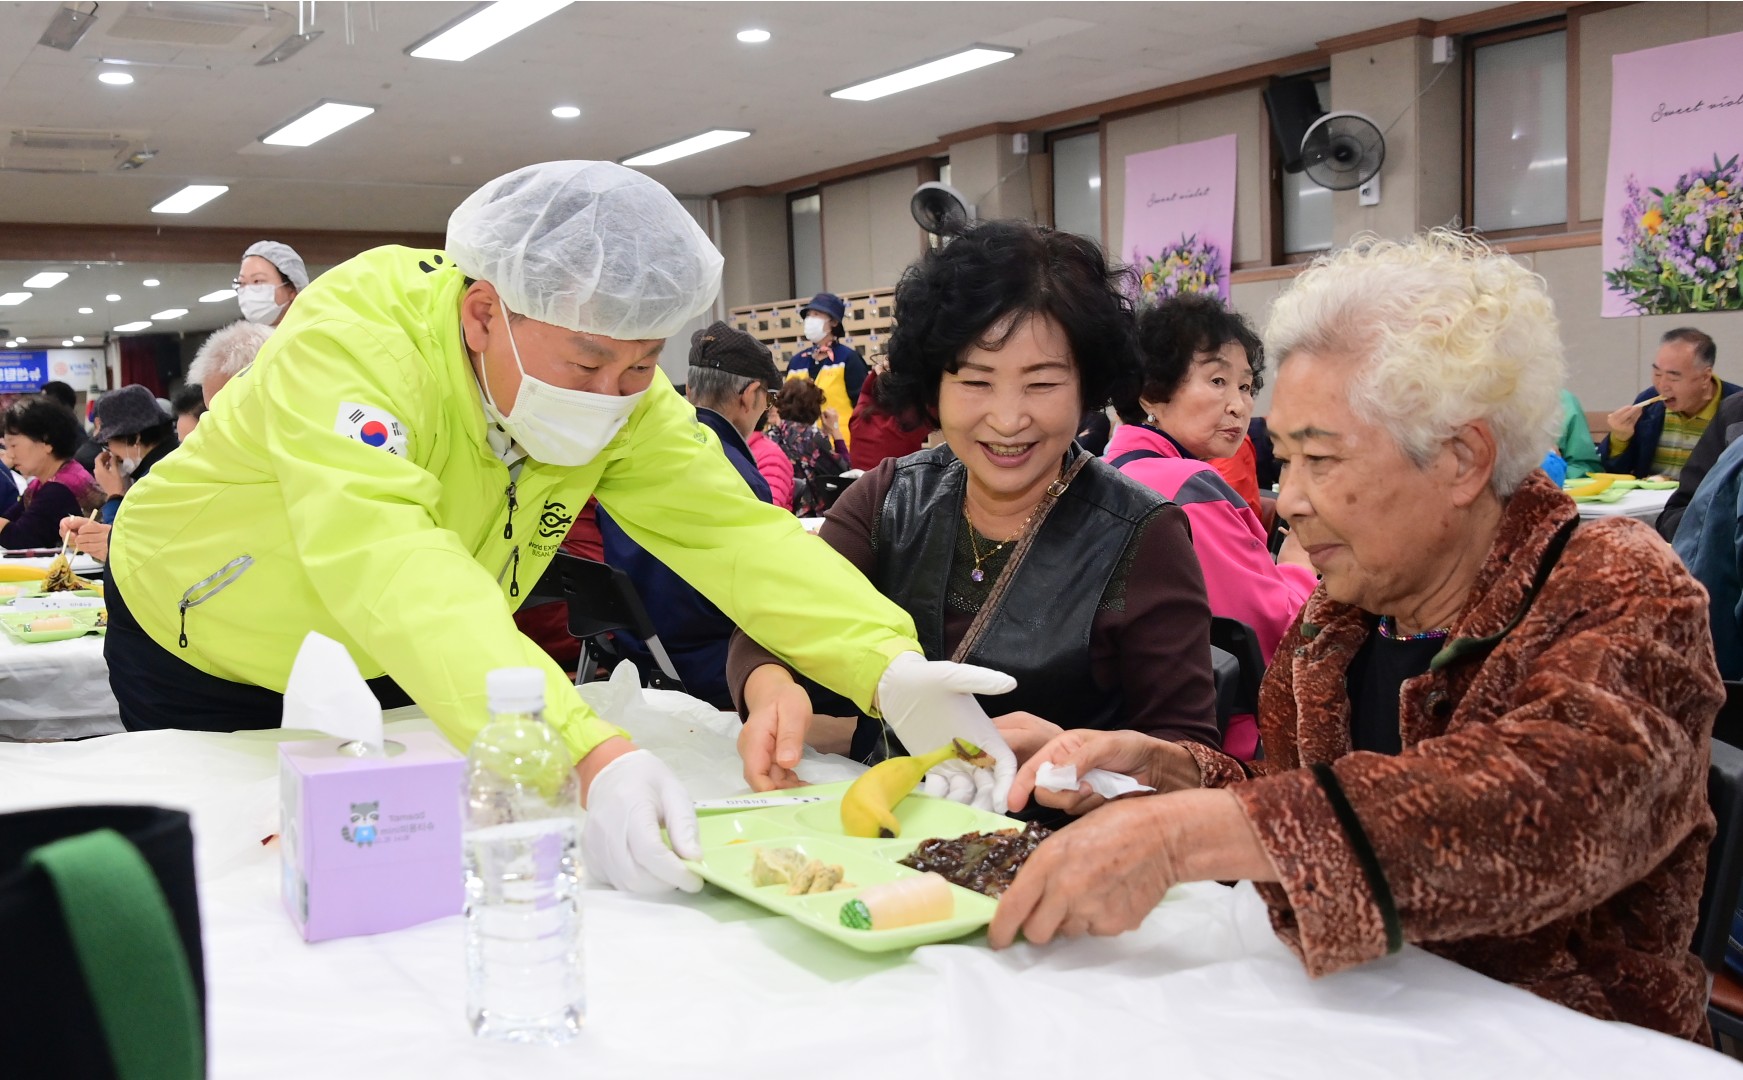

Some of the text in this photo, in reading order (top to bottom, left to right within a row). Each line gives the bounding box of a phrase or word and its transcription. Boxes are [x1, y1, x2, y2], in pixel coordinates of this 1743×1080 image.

[1651, 101, 1704, 122] Sweet
[1146, 187, 1210, 208] Sweet violet
